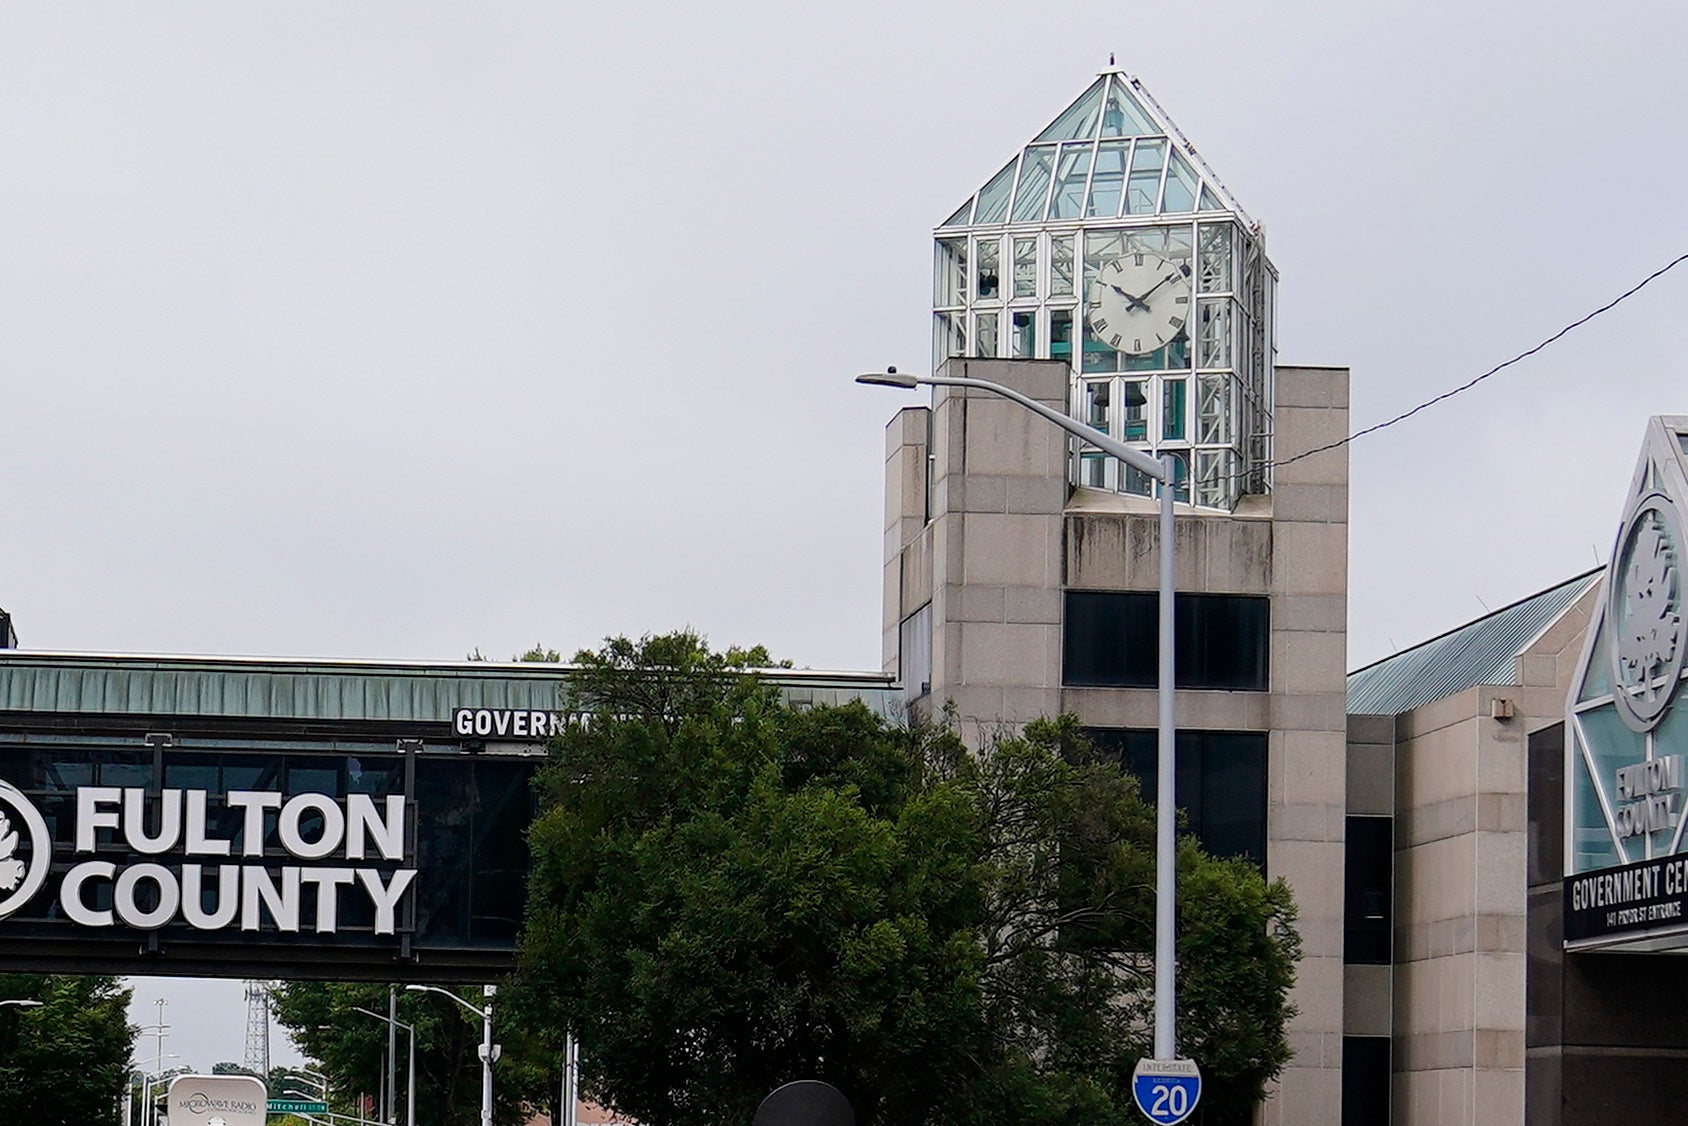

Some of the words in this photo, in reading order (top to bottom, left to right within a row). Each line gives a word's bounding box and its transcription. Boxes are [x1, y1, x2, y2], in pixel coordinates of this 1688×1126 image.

[75, 786, 406, 862] FULTON
[59, 860, 418, 935] COUNTY
[1572, 864, 1661, 912] GOVERNMENT
[266, 1102, 307, 1111] Mitchell
[1151, 1084, 1188, 1117] 20
